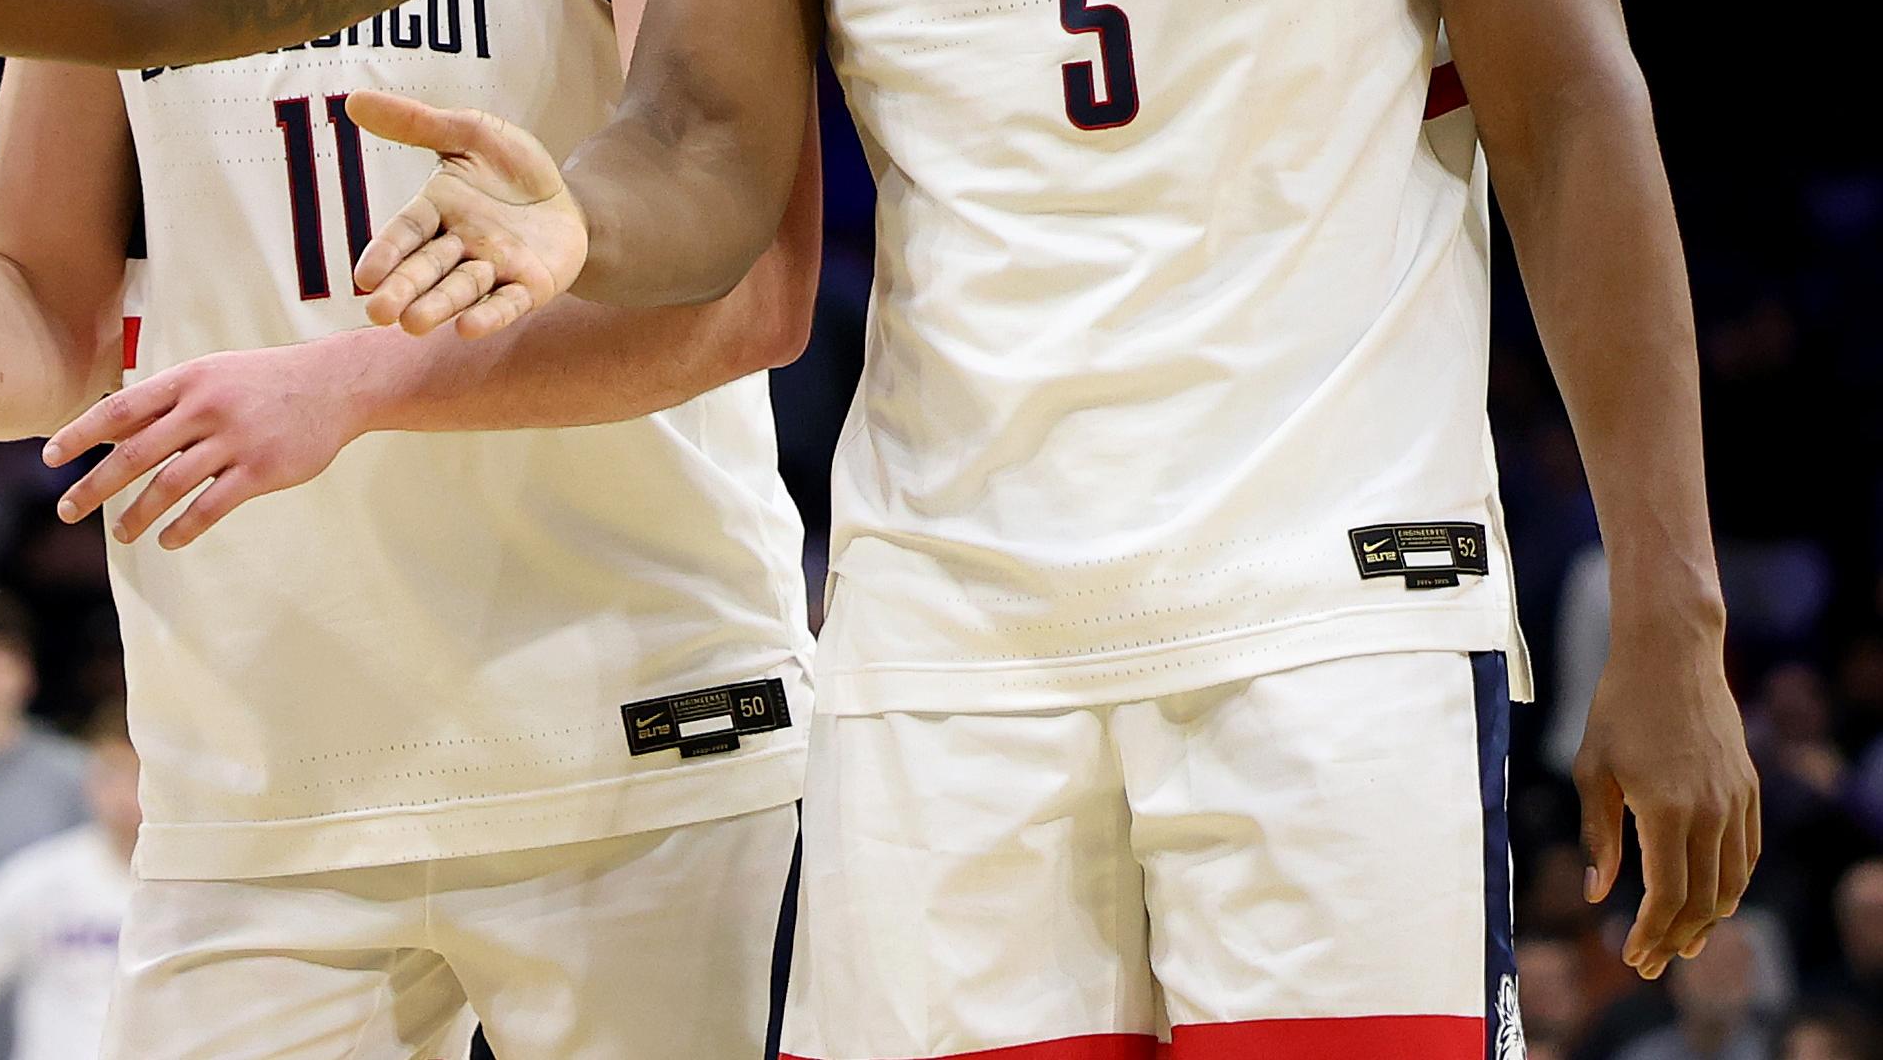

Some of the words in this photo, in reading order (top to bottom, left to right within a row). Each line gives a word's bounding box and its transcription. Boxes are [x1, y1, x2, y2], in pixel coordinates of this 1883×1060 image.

[274, 93, 373, 301] 11
[1456, 536, 1477, 558] 52
[739, 696, 765, 718] 50
